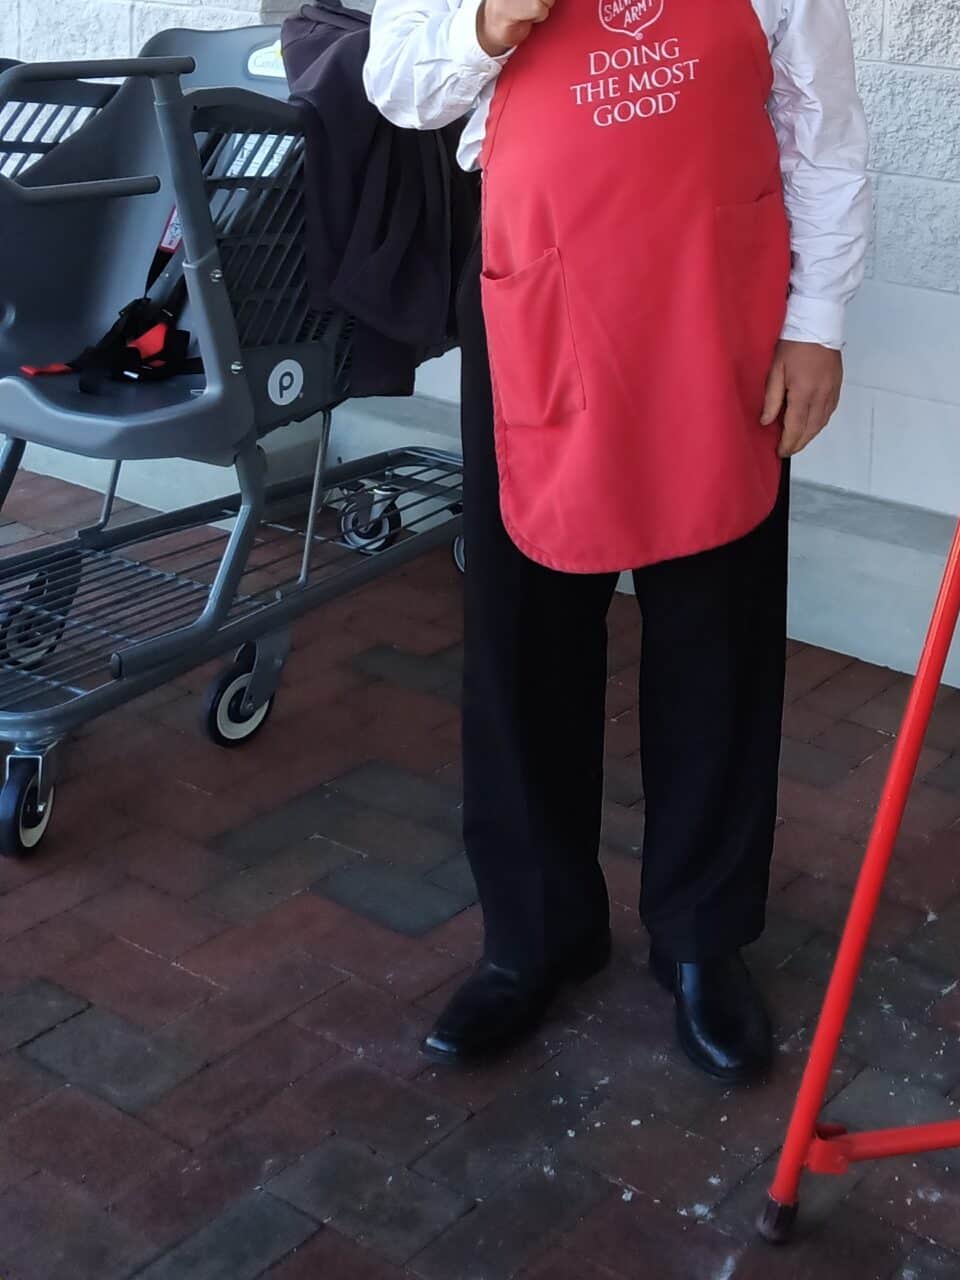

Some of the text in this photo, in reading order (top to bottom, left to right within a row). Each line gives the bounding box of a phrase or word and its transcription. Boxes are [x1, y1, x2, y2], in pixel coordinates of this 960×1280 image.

[589, 38, 680, 76] DOING
[570, 58, 699, 105] THE MOST
[593, 91, 678, 127] GOOD
